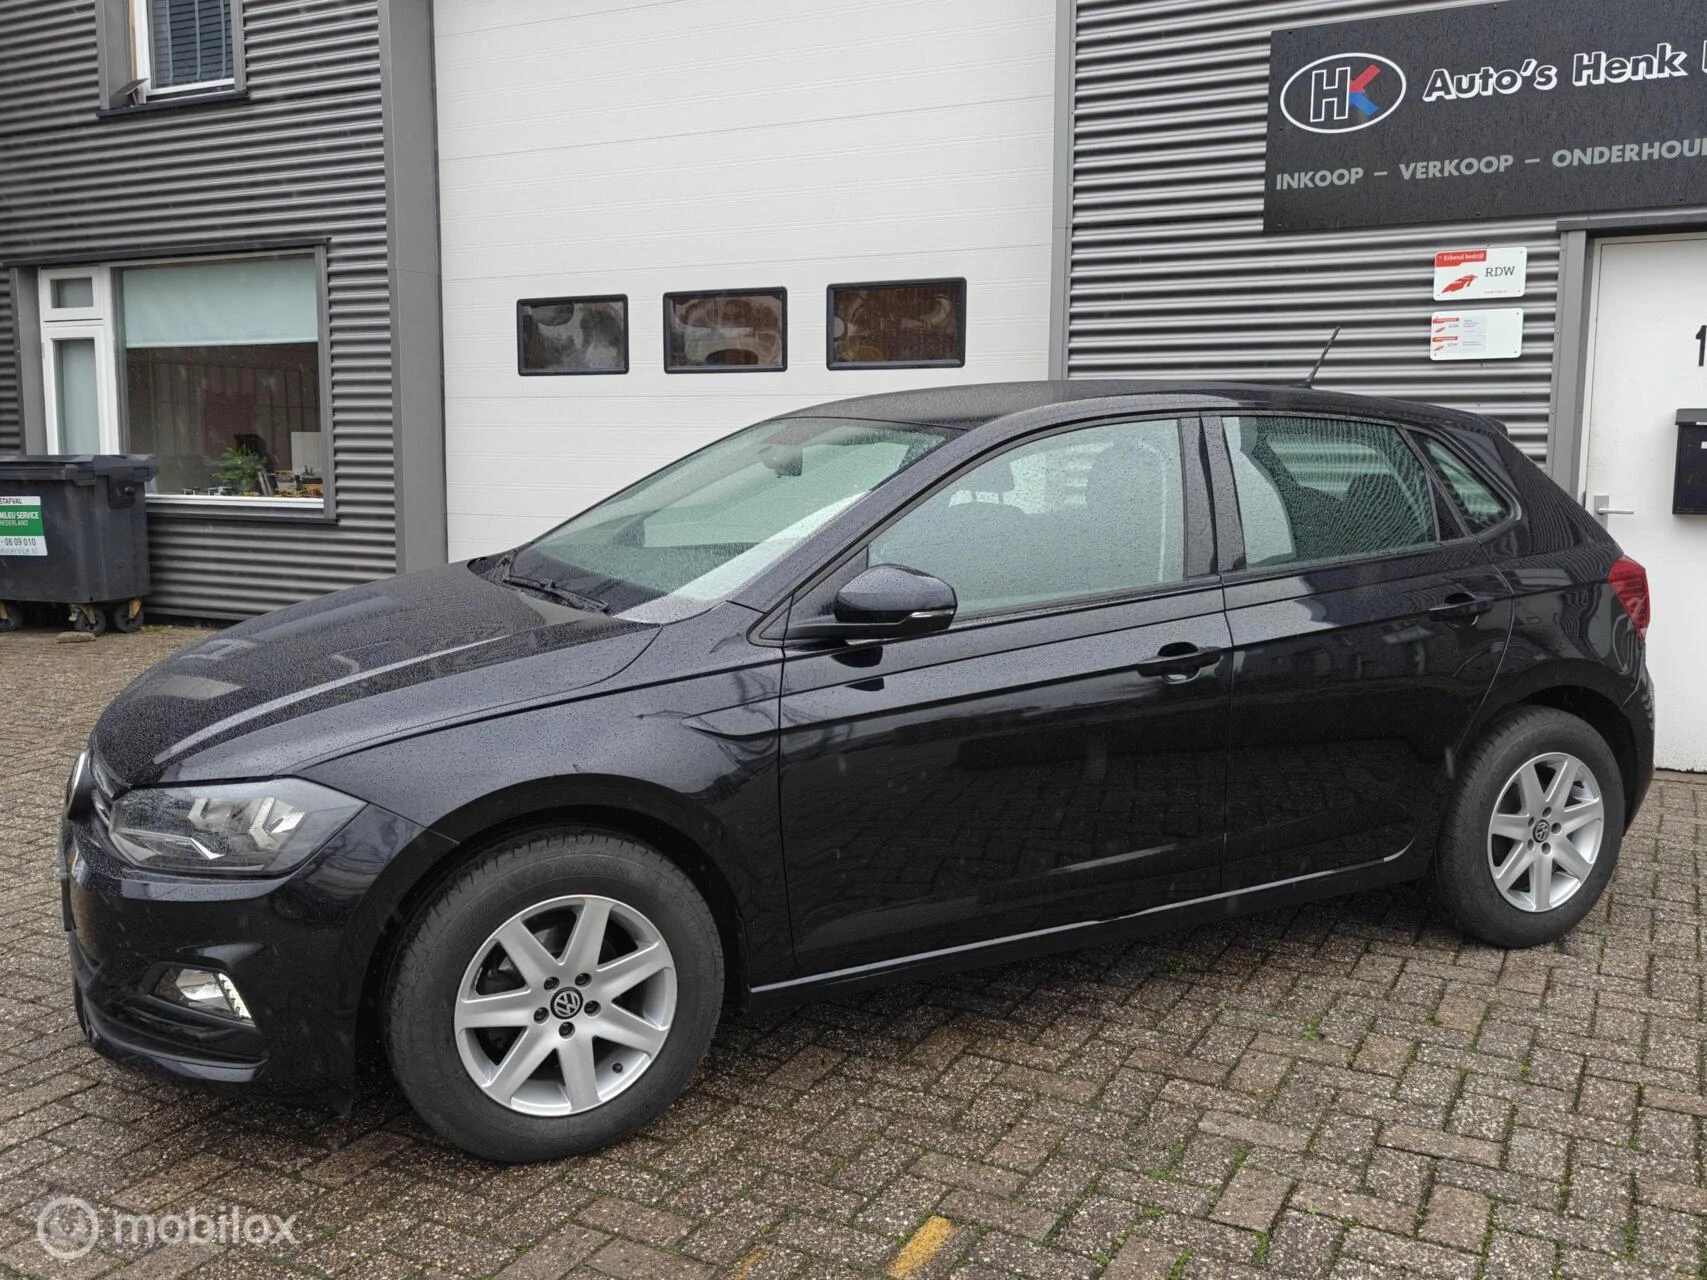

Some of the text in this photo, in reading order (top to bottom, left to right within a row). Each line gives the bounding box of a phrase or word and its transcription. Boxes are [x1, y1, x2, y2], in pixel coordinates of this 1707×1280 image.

[1422, 58, 1557, 102] Auto's
[1572, 43, 1688, 87] Henk
[1276, 167, 1364, 190] INKOOP
[1399, 154, 1514, 180] VERKOOP
[1552, 138, 1707, 168] ONDERHOU
[1485, 266, 1515, 277] RDW
[16, 511, 39, 520] SERVICE
